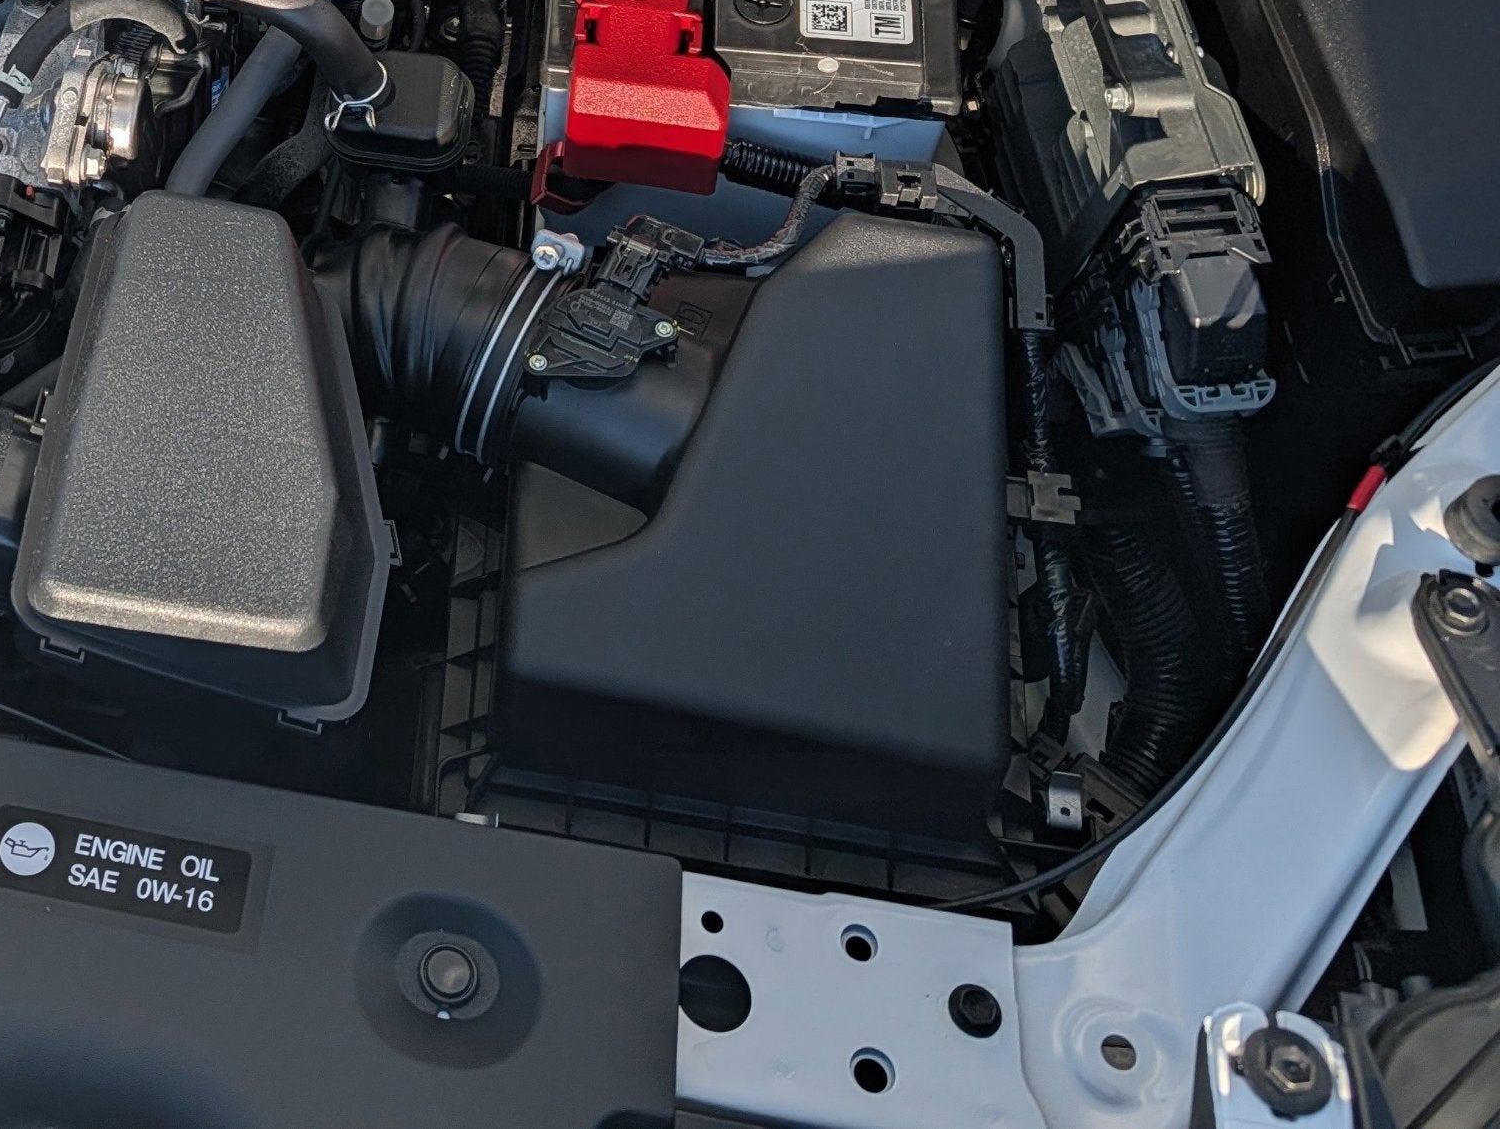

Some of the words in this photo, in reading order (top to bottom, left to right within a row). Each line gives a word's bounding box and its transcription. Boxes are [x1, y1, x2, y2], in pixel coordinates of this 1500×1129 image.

[874, 17, 902, 35] TM
[73, 833, 167, 871] ENGINE
[180, 854, 222, 882] OIL
[67, 863, 121, 894] SAE
[135, 876, 215, 913] 0W-16
